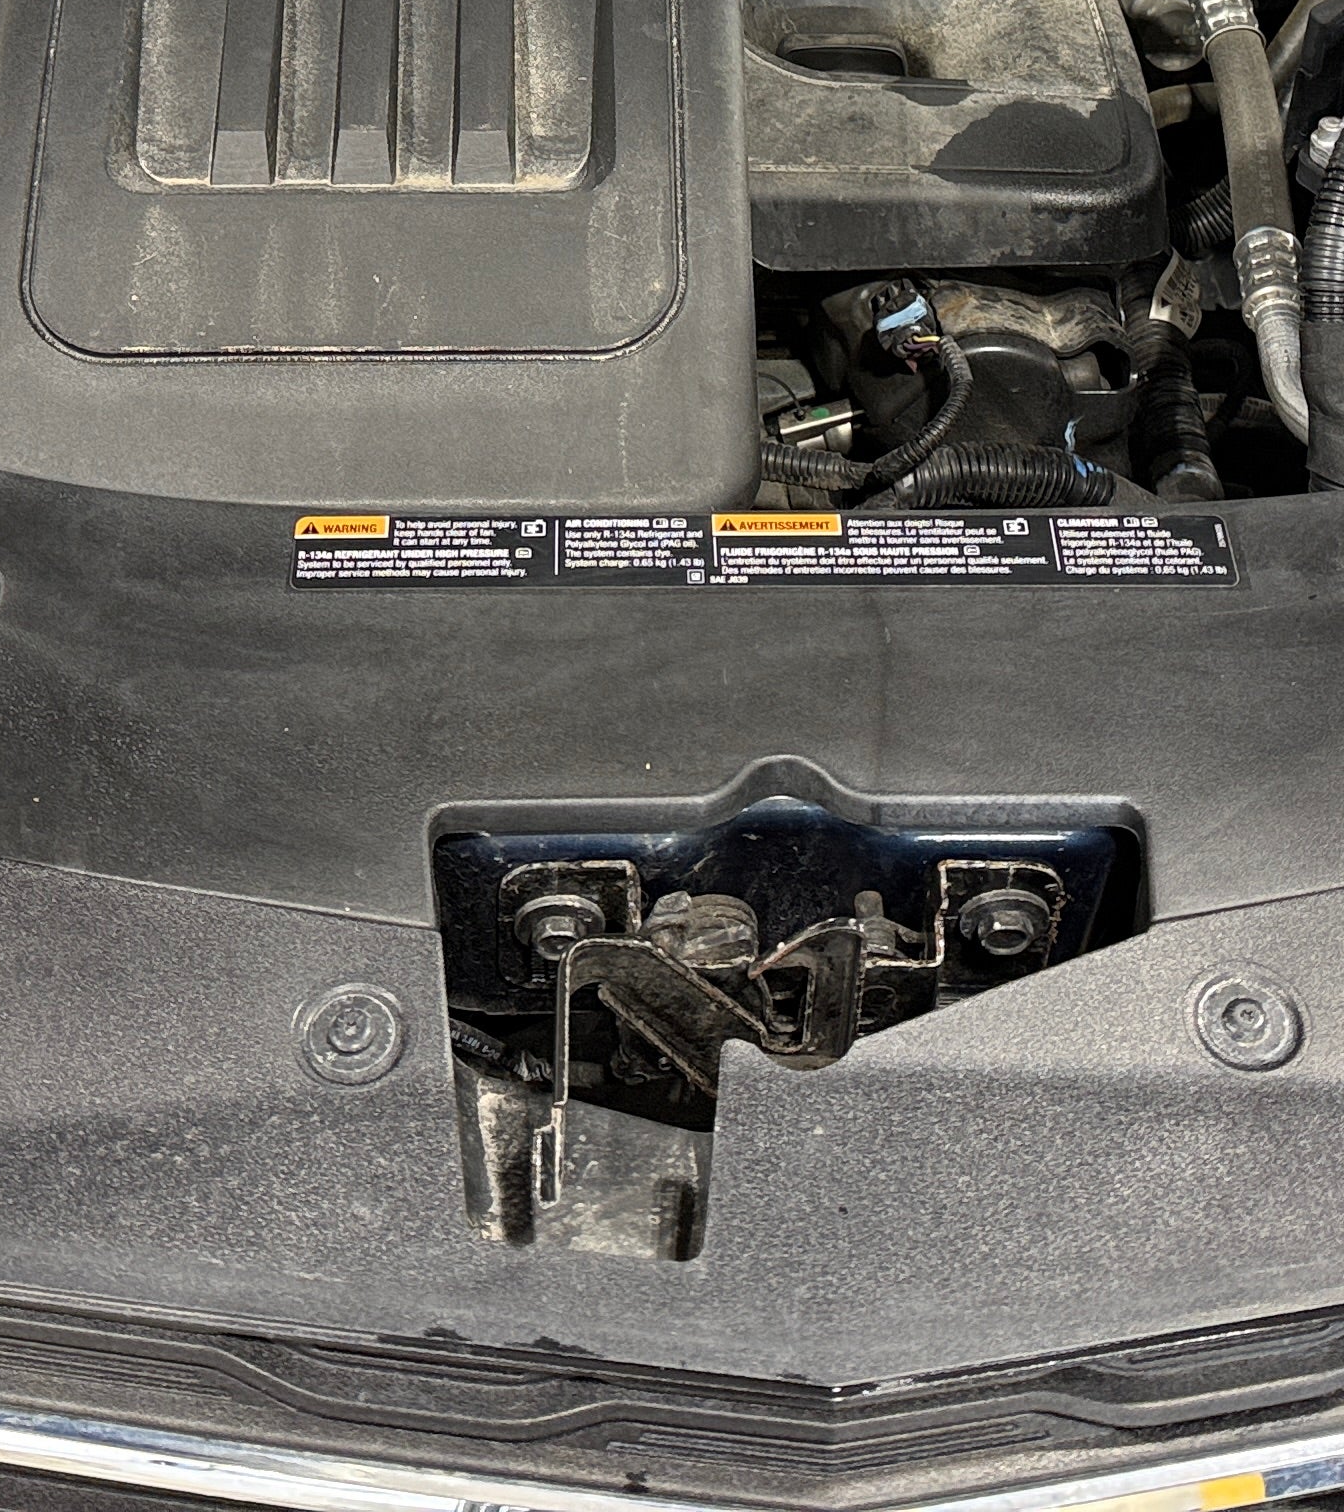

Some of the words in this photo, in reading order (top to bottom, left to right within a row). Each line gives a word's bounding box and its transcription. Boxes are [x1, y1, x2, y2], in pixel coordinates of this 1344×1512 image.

[565, 519, 582, 528] AIR
[583, 519, 649, 528] CONDITIONING
[739, 521, 831, 531] AVERTISSEMENT
[1057, 518, 1119, 527] CLIMATISEUR
[323, 524, 378, 534] WARNING
[565, 530, 582, 538] Use
[583, 530, 602, 539] only
[603, 530, 636, 538] R-134a
[637, 530, 684, 539] Refrigerant
[686, 530, 703, 538] and
[298, 549, 333, 559] R-134a
[334, 549, 401, 559] REFRIGERANT
[401, 549, 434, 559] UNDER
[435, 549, 459, 559] HIGH
[460, 549, 510, 559] PRESSURE
[565, 549, 581, 557] The
[583, 549, 615, 559] system
[616, 549, 653, 558] contains
[654, 549, 674, 558] dye.
[720, 547, 753, 556] FLUIDE
[817, 547, 851, 556] R-134a
[852, 547, 878, 556] SOUS
[879, 547, 911, 556] HAUTE
[911, 547, 959, 556] PRESSION
[297, 560, 331, 570] System
[332, 559, 342, 568] to
[343, 559, 355, 568] be
[356, 559, 394, 568] serviced
[395, 560, 407, 569] by
[407, 559, 446, 568] qualified
[447, 559, 491, 568] personnel
[492, 559, 512, 568] only.
[564, 558, 597, 568] System
[598, 558, 632, 568] charge:
[633, 558, 654, 567] 0.65
[655, 558, 667, 568] kg
[668, 558, 691, 568] (1.43
[692, 558, 705, 568] lb)
[296, 569, 337, 579] Improper
[338, 569, 371, 578] service
[371, 569, 411, 578] methods
[411, 569, 432, 578] may
[433, 569, 460, 577] cause
[461, 568, 500, 578] personal
[501, 568, 528, 578] injury.
